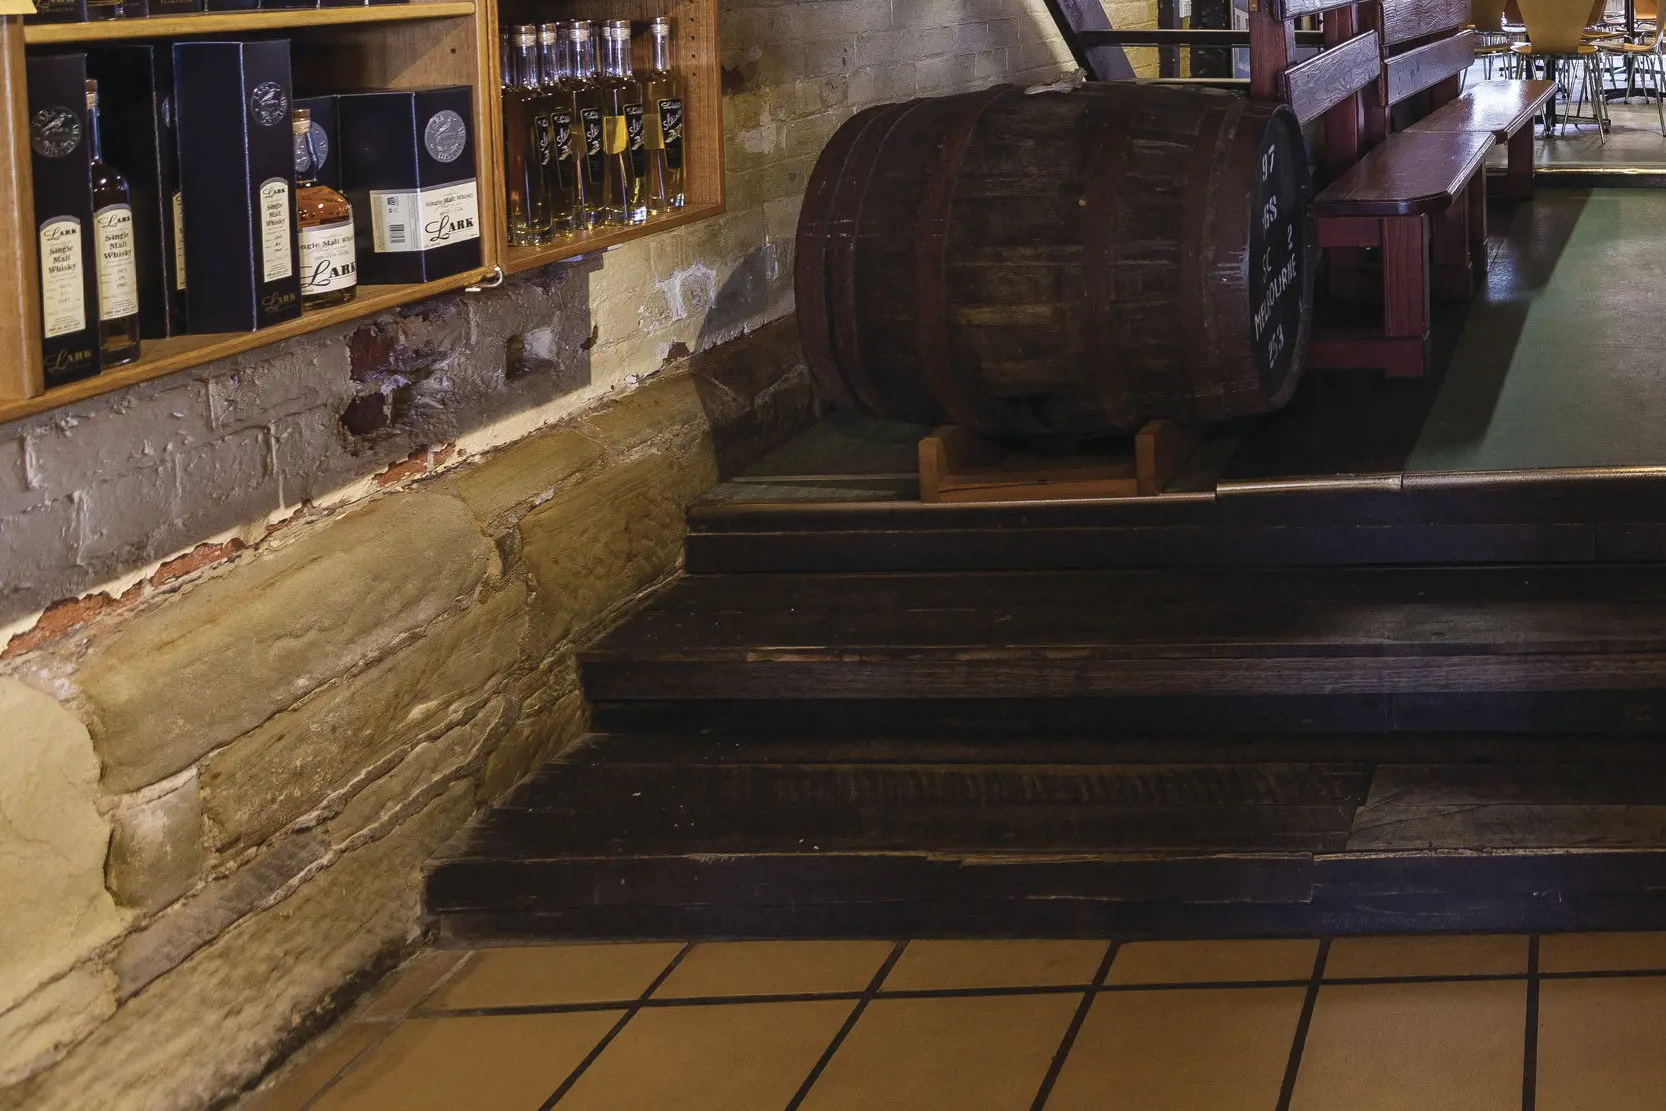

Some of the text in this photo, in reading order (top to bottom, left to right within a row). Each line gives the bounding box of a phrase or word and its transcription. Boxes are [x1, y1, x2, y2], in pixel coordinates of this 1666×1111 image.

[1262, 144, 1275, 182] 97
[262, 186, 286, 198] LARK
[425, 192, 474, 207] Single Malt Whisky
[98, 215, 131, 229] LARK
[266, 218, 285, 227] Whisky
[44, 226, 77, 241] LARK
[425, 215, 475, 242] LARK
[105, 232, 129, 243] Single
[301, 238, 320, 250] ngle
[322, 237, 340, 247] Malt
[49, 245, 73, 256] Single
[109, 242, 127, 251] Malt
[52, 256, 71, 264] Malt
[104, 248, 132, 260] Whisky
[48, 263, 76, 274] Whisky
[1254, 252, 1297, 341] MELBOURNE
